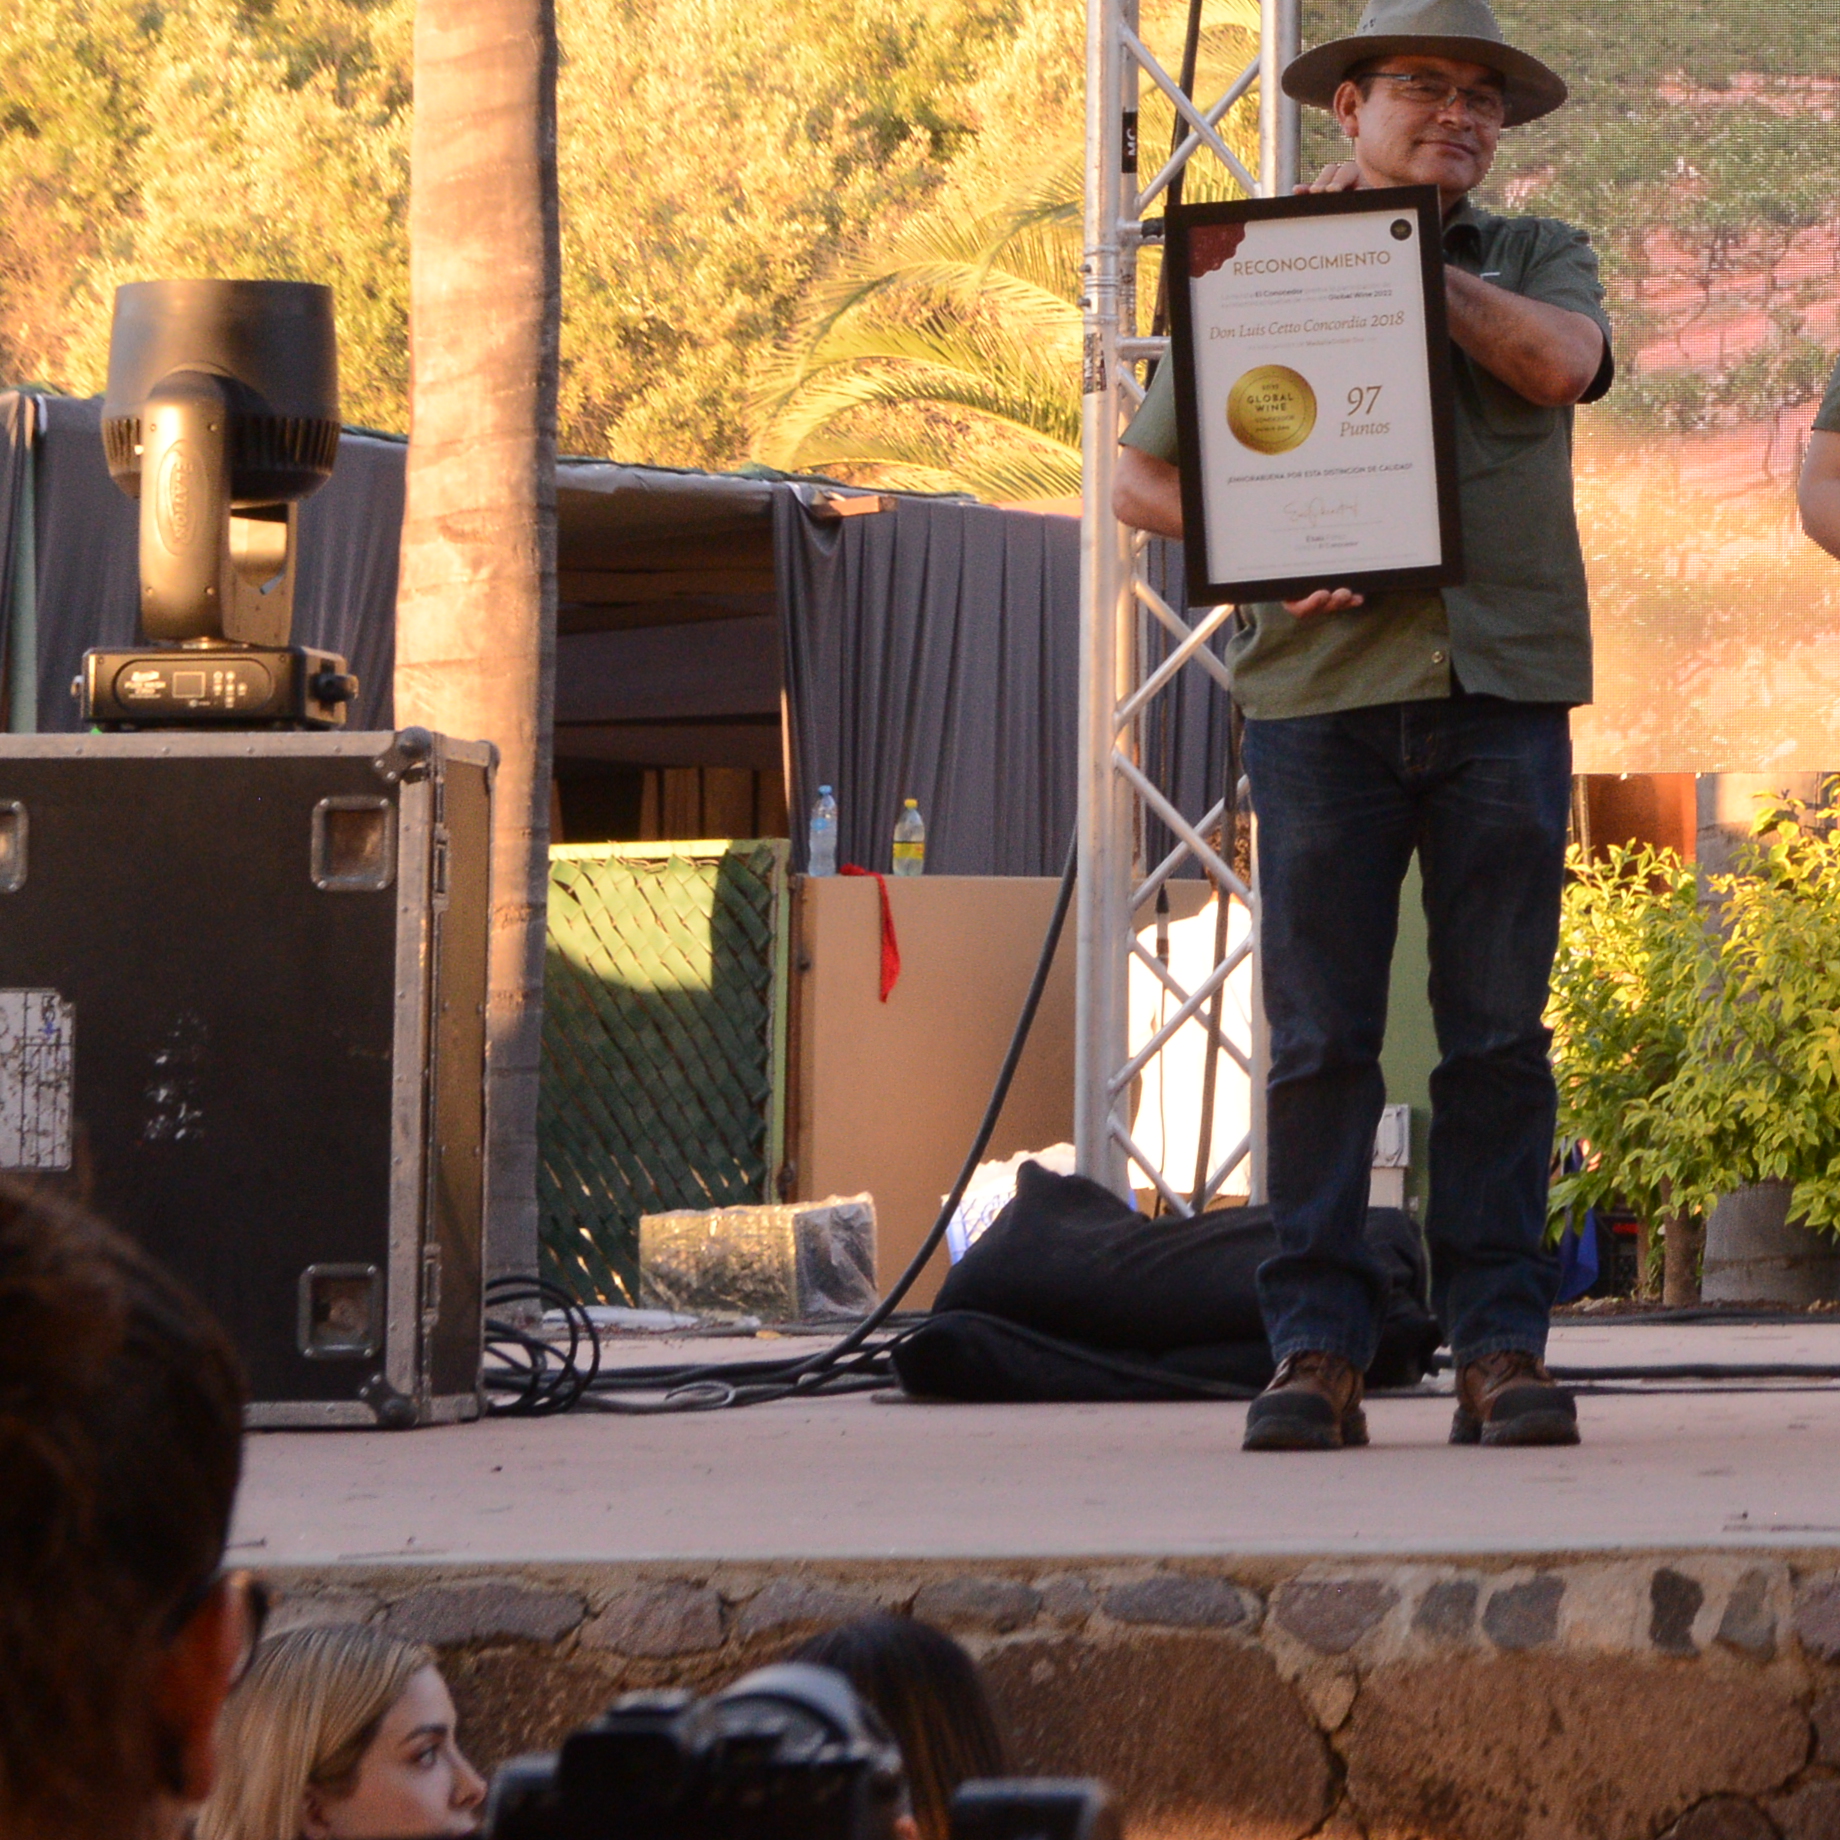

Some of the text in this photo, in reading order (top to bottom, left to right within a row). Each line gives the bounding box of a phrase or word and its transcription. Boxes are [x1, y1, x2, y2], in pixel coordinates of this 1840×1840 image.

[1233, 250, 1391, 276] RECONOCIMIENTO
[1328, 289, 1393, 301] Global Wine 2022
[1210, 310, 1405, 340] Don Luis Cetto Concordia 2018
[1247, 394, 1294, 404] GLOBAL
[1347, 385, 1383, 416] 97
[1255, 403, 1287, 412] WINE
[1340, 421, 1391, 437] Puntos
[1287, 471, 1302, 479] POR
[1304, 469, 1321, 477] ESTA
[1368, 465, 1377, 473] DE
